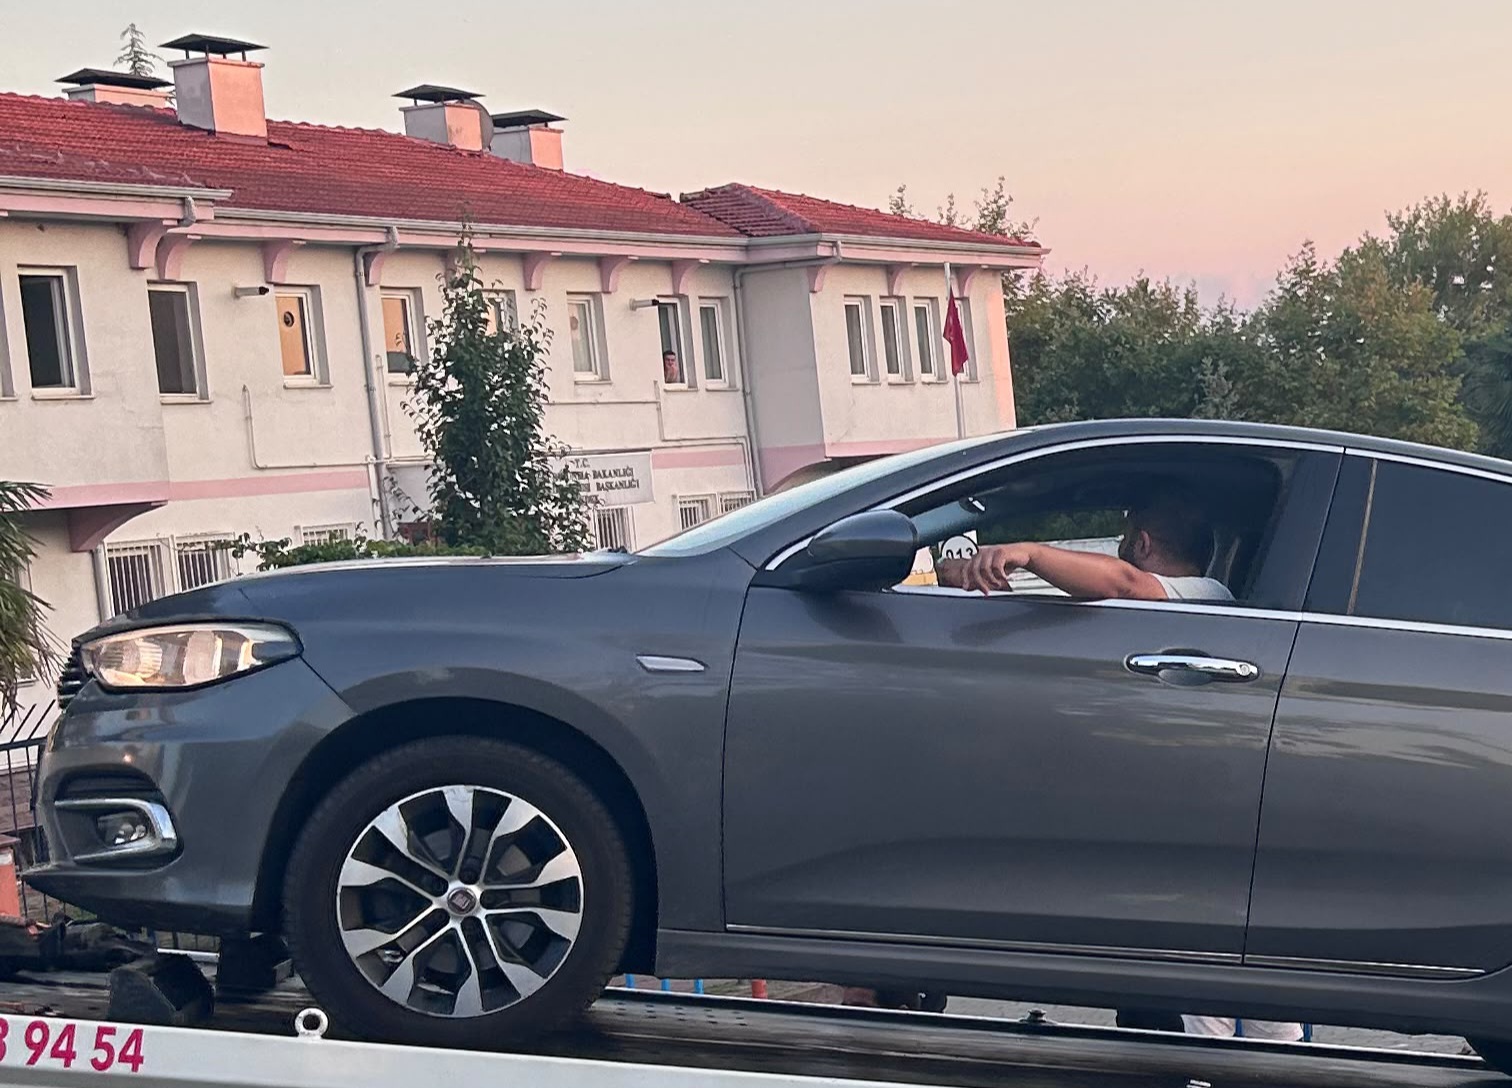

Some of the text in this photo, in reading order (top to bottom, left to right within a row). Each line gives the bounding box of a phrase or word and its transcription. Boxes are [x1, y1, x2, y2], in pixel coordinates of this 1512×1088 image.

[596, 478, 640, 492] BAŞKANLIĞI
[24, 1020, 77, 1068] 94
[90, 1026, 144, 1073] 54
